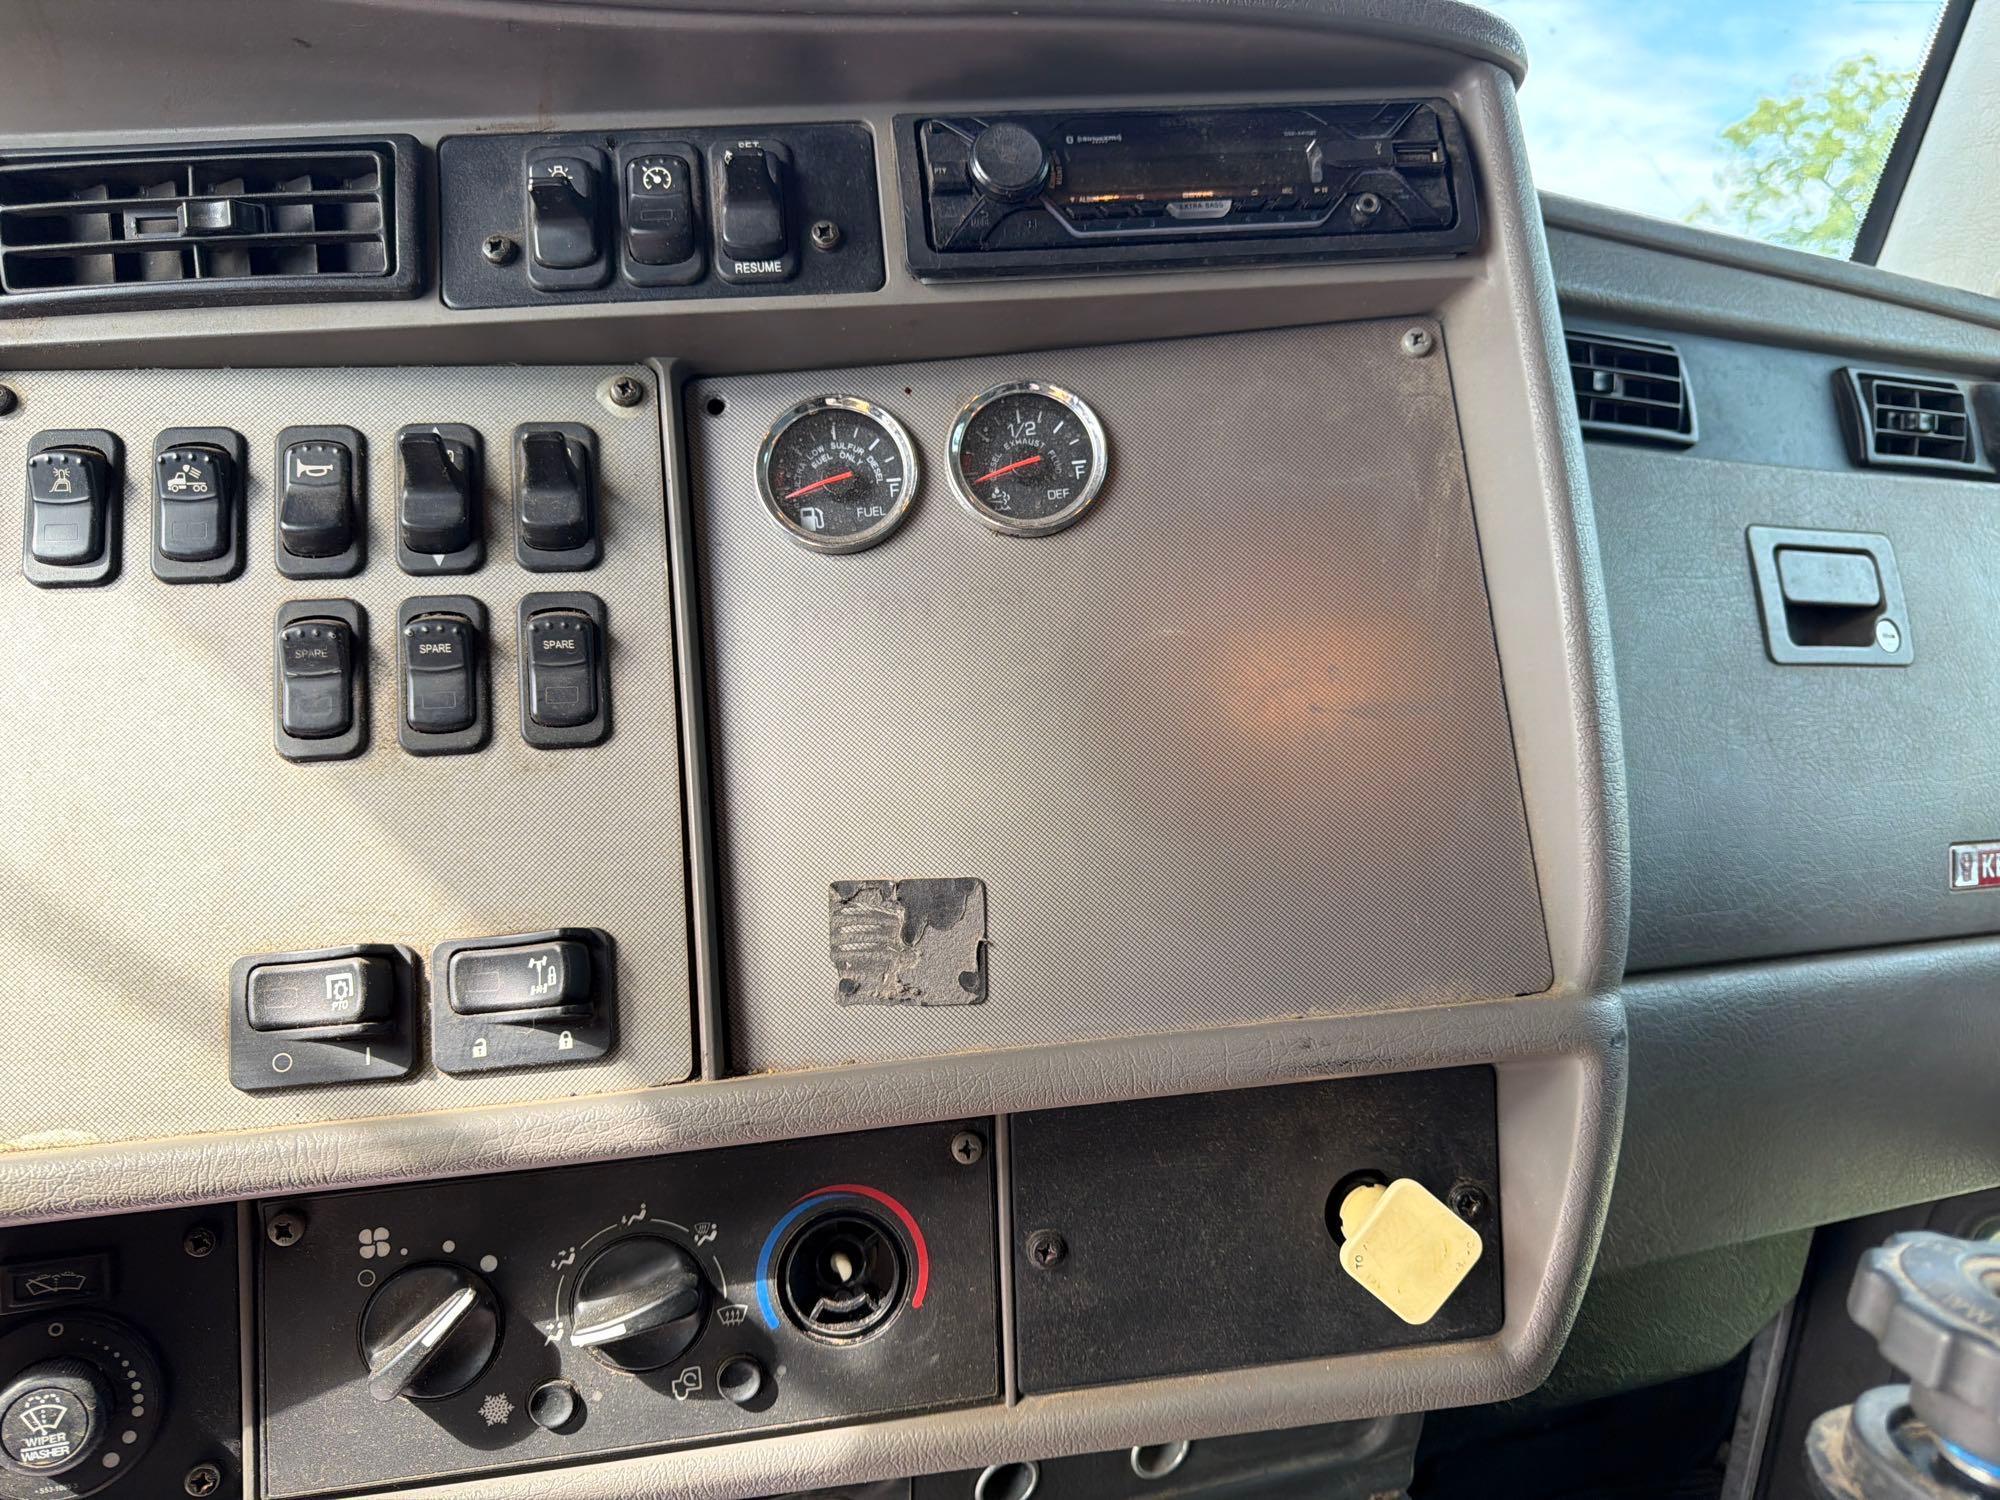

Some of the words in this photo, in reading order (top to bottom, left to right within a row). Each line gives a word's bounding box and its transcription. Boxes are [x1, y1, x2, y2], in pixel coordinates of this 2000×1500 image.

[735, 260, 782, 274] RESUME
[1007, 421, 1037, 438] 1/2
[807, 445, 825, 460] LOW
[830, 442, 865, 456] SULFUR
[866, 455, 883, 484] DIESEL
[811, 453, 833, 469] FUEL
[839, 451, 864, 466] ONLY
[1003, 438, 1047, 451] EXHAUST
[1047, 450, 1062, 474] FLUID
[1076, 465, 1086, 480] F
[889, 483, 900, 498] F
[1047, 488, 1070, 500] DEF
[857, 506, 886, 518] FUEL
[419, 644, 452, 654] SPARE
[543, 639, 575, 650] SPARE
[295, 648, 328, 659] SPARE
[331, 1000, 348, 1011] PTO
[26, 1432, 66, 1447] WIPER
[21, 1446, 70, 1462] WASHER
